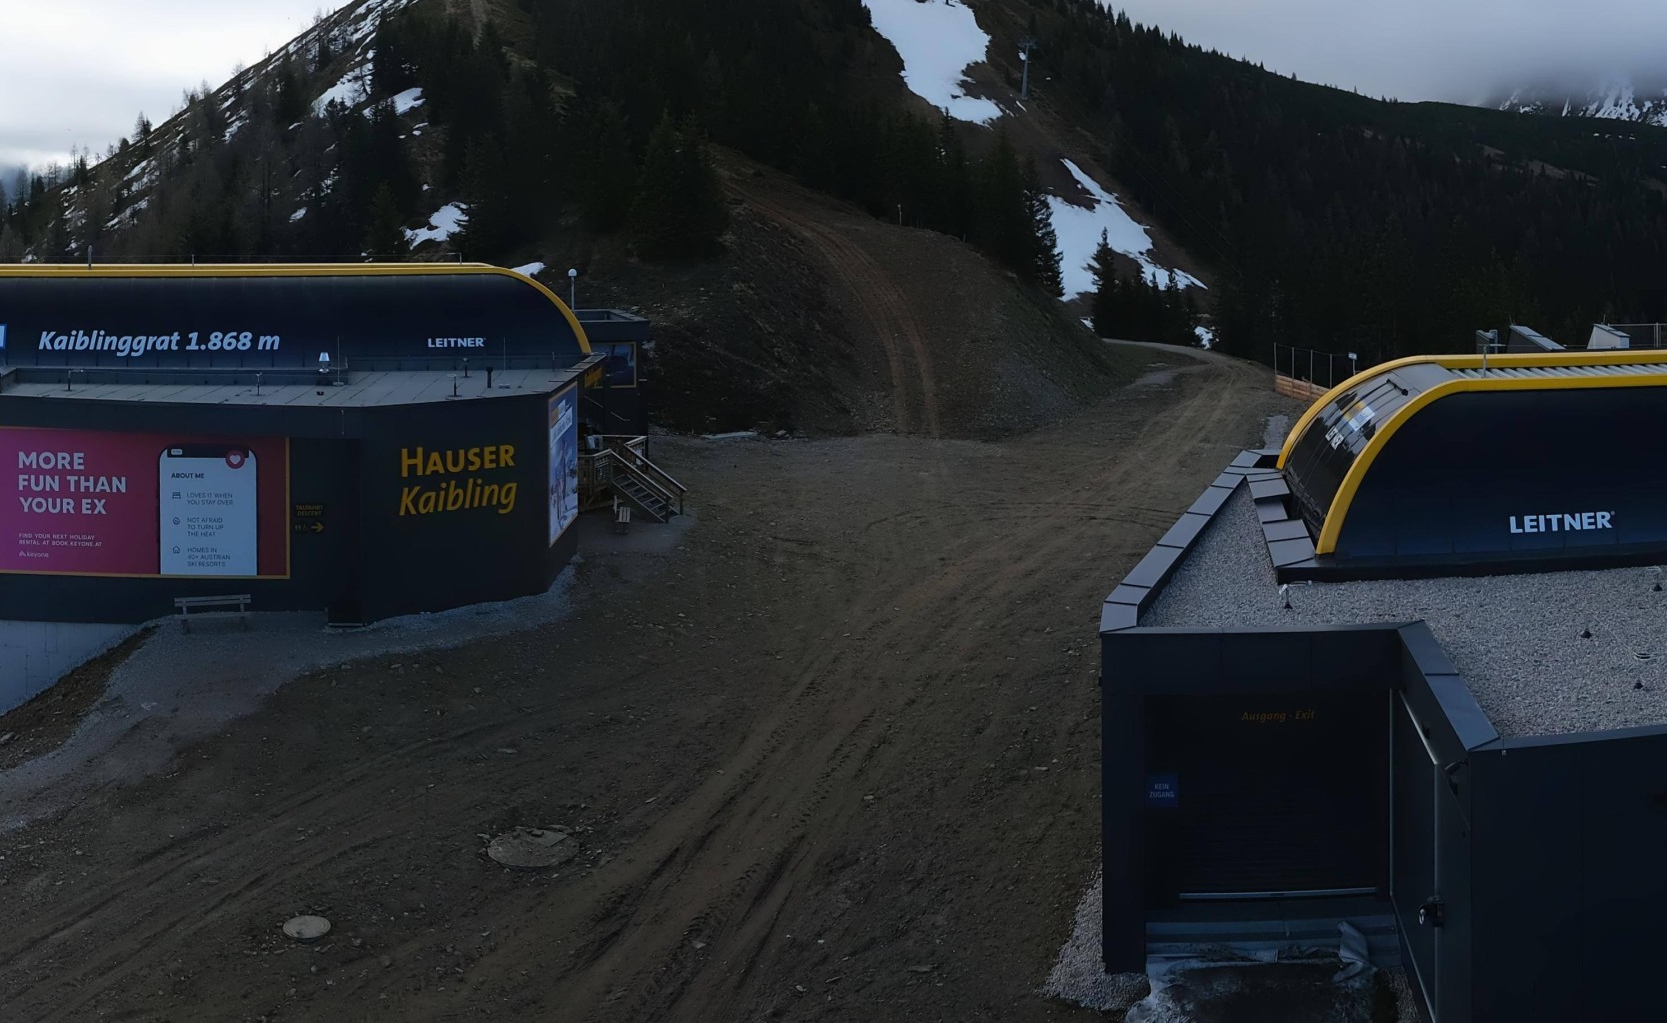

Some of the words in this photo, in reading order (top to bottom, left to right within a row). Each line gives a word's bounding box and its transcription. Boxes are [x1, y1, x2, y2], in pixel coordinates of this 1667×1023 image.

[38, 330, 180, 357] Kaiblinggrat
[185, 331, 253, 351] 1.868
[257, 335, 280, 351] m
[427, 337, 485, 348] LEITNER
[18, 451, 85, 470] MORE
[401, 444, 515, 478] HAUSER
[18, 474, 60, 492] FUN
[66, 475, 126, 493] THAN
[19, 497, 75, 514] YOUR
[81, 498, 107, 514] EX
[399, 478, 518, 516] Kaibling
[1509, 511, 1613, 534] LEITNER
[1241, 710, 1287, 723] Ausgang
[1295, 709, 1316, 720] Exit
